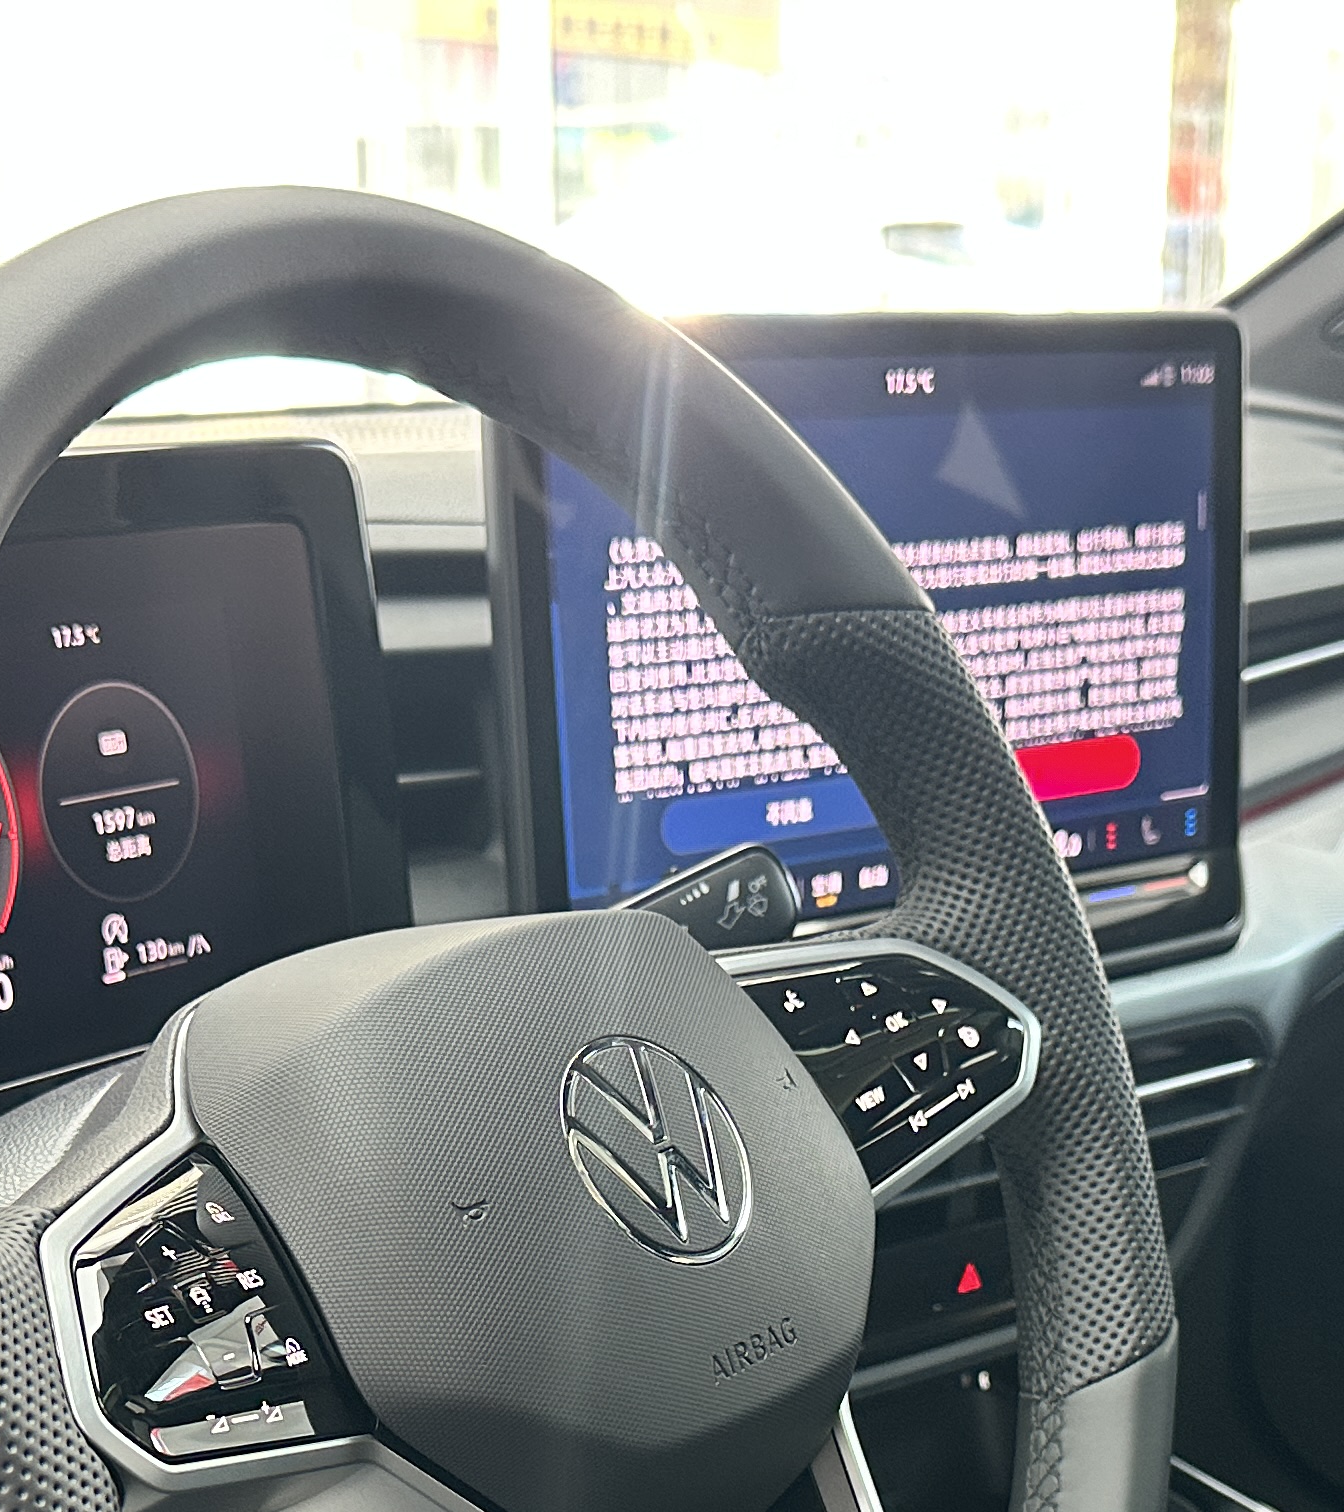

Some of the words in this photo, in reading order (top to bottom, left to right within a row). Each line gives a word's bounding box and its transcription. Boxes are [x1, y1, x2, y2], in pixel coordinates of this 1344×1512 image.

[92, 805, 135, 835] 1597
[144, 1305, 176, 1329] SET
[711, 1317, 798, 1386] AIRBAG
